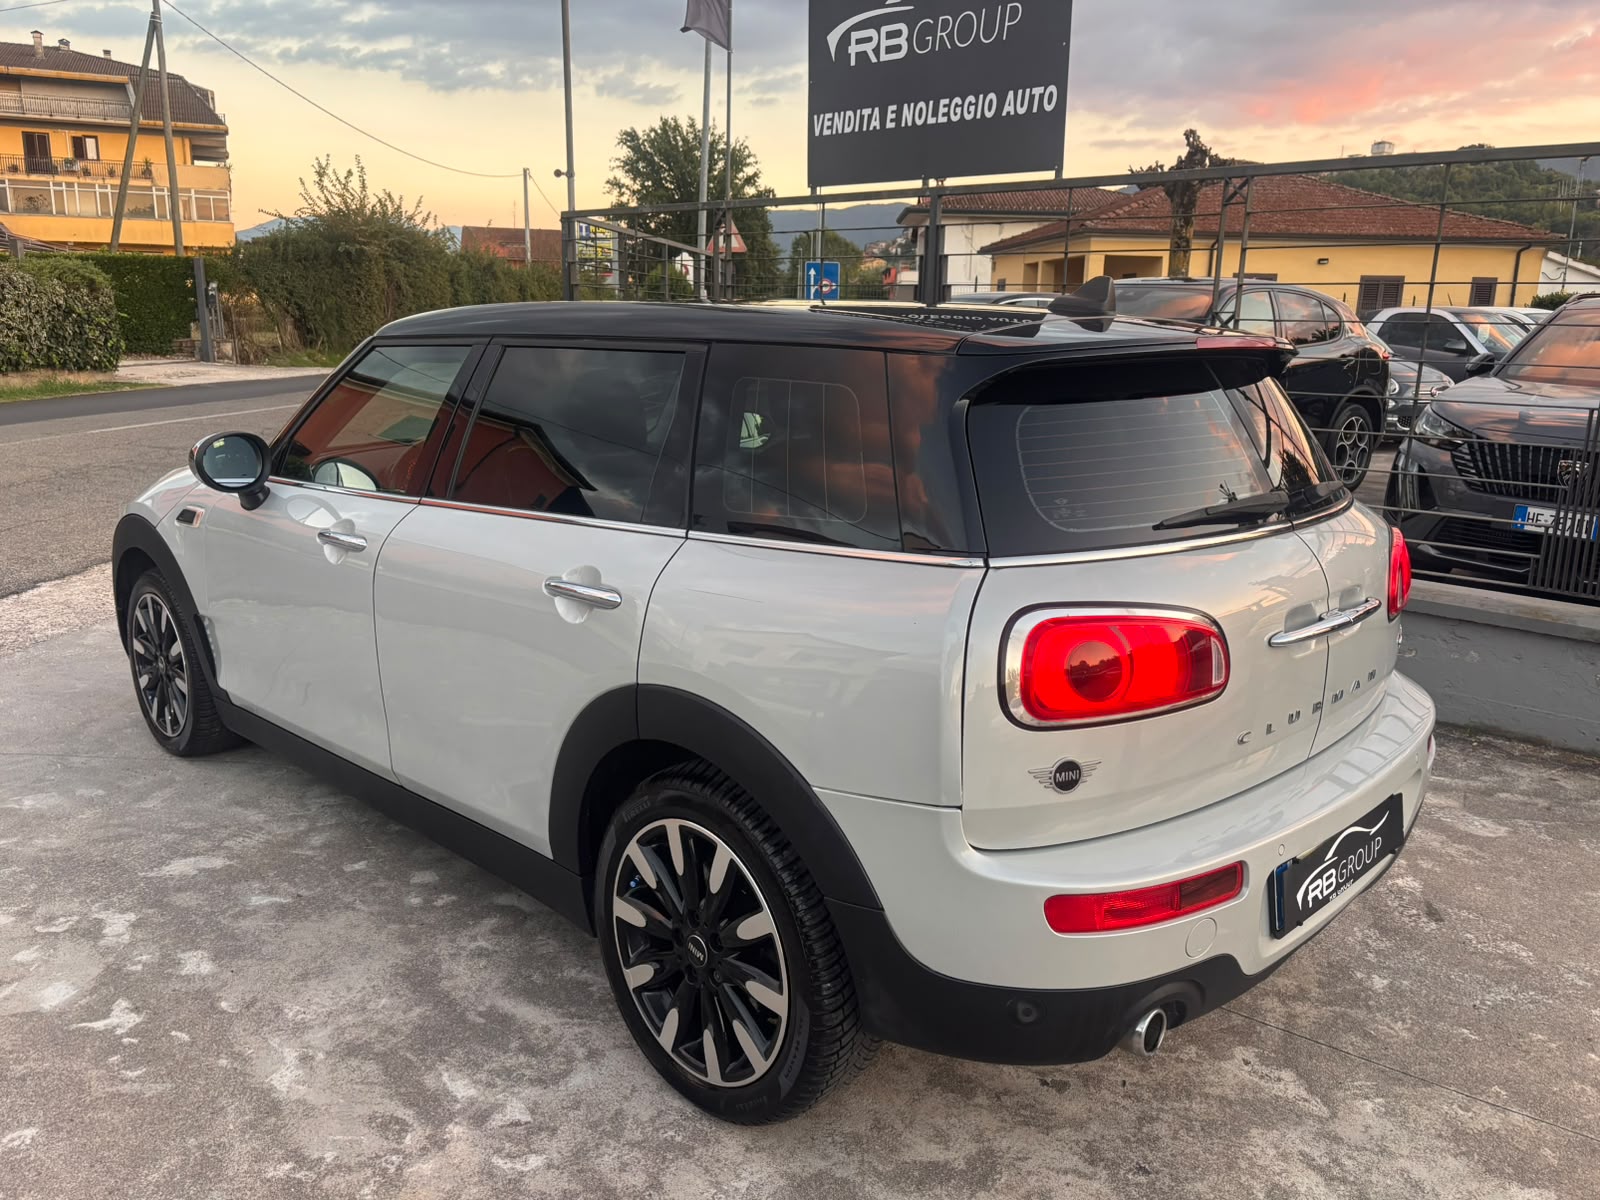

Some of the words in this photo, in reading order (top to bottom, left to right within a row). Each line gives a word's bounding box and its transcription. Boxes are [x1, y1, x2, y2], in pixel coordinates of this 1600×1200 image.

[813, 107, 880, 136] VENDITA
[886, 105, 898, 129] E
[901, 92, 997, 127] NOLEGGIO
[1002, 84, 1058, 116] AUTO
[1056, 769, 1080, 783] MINI
